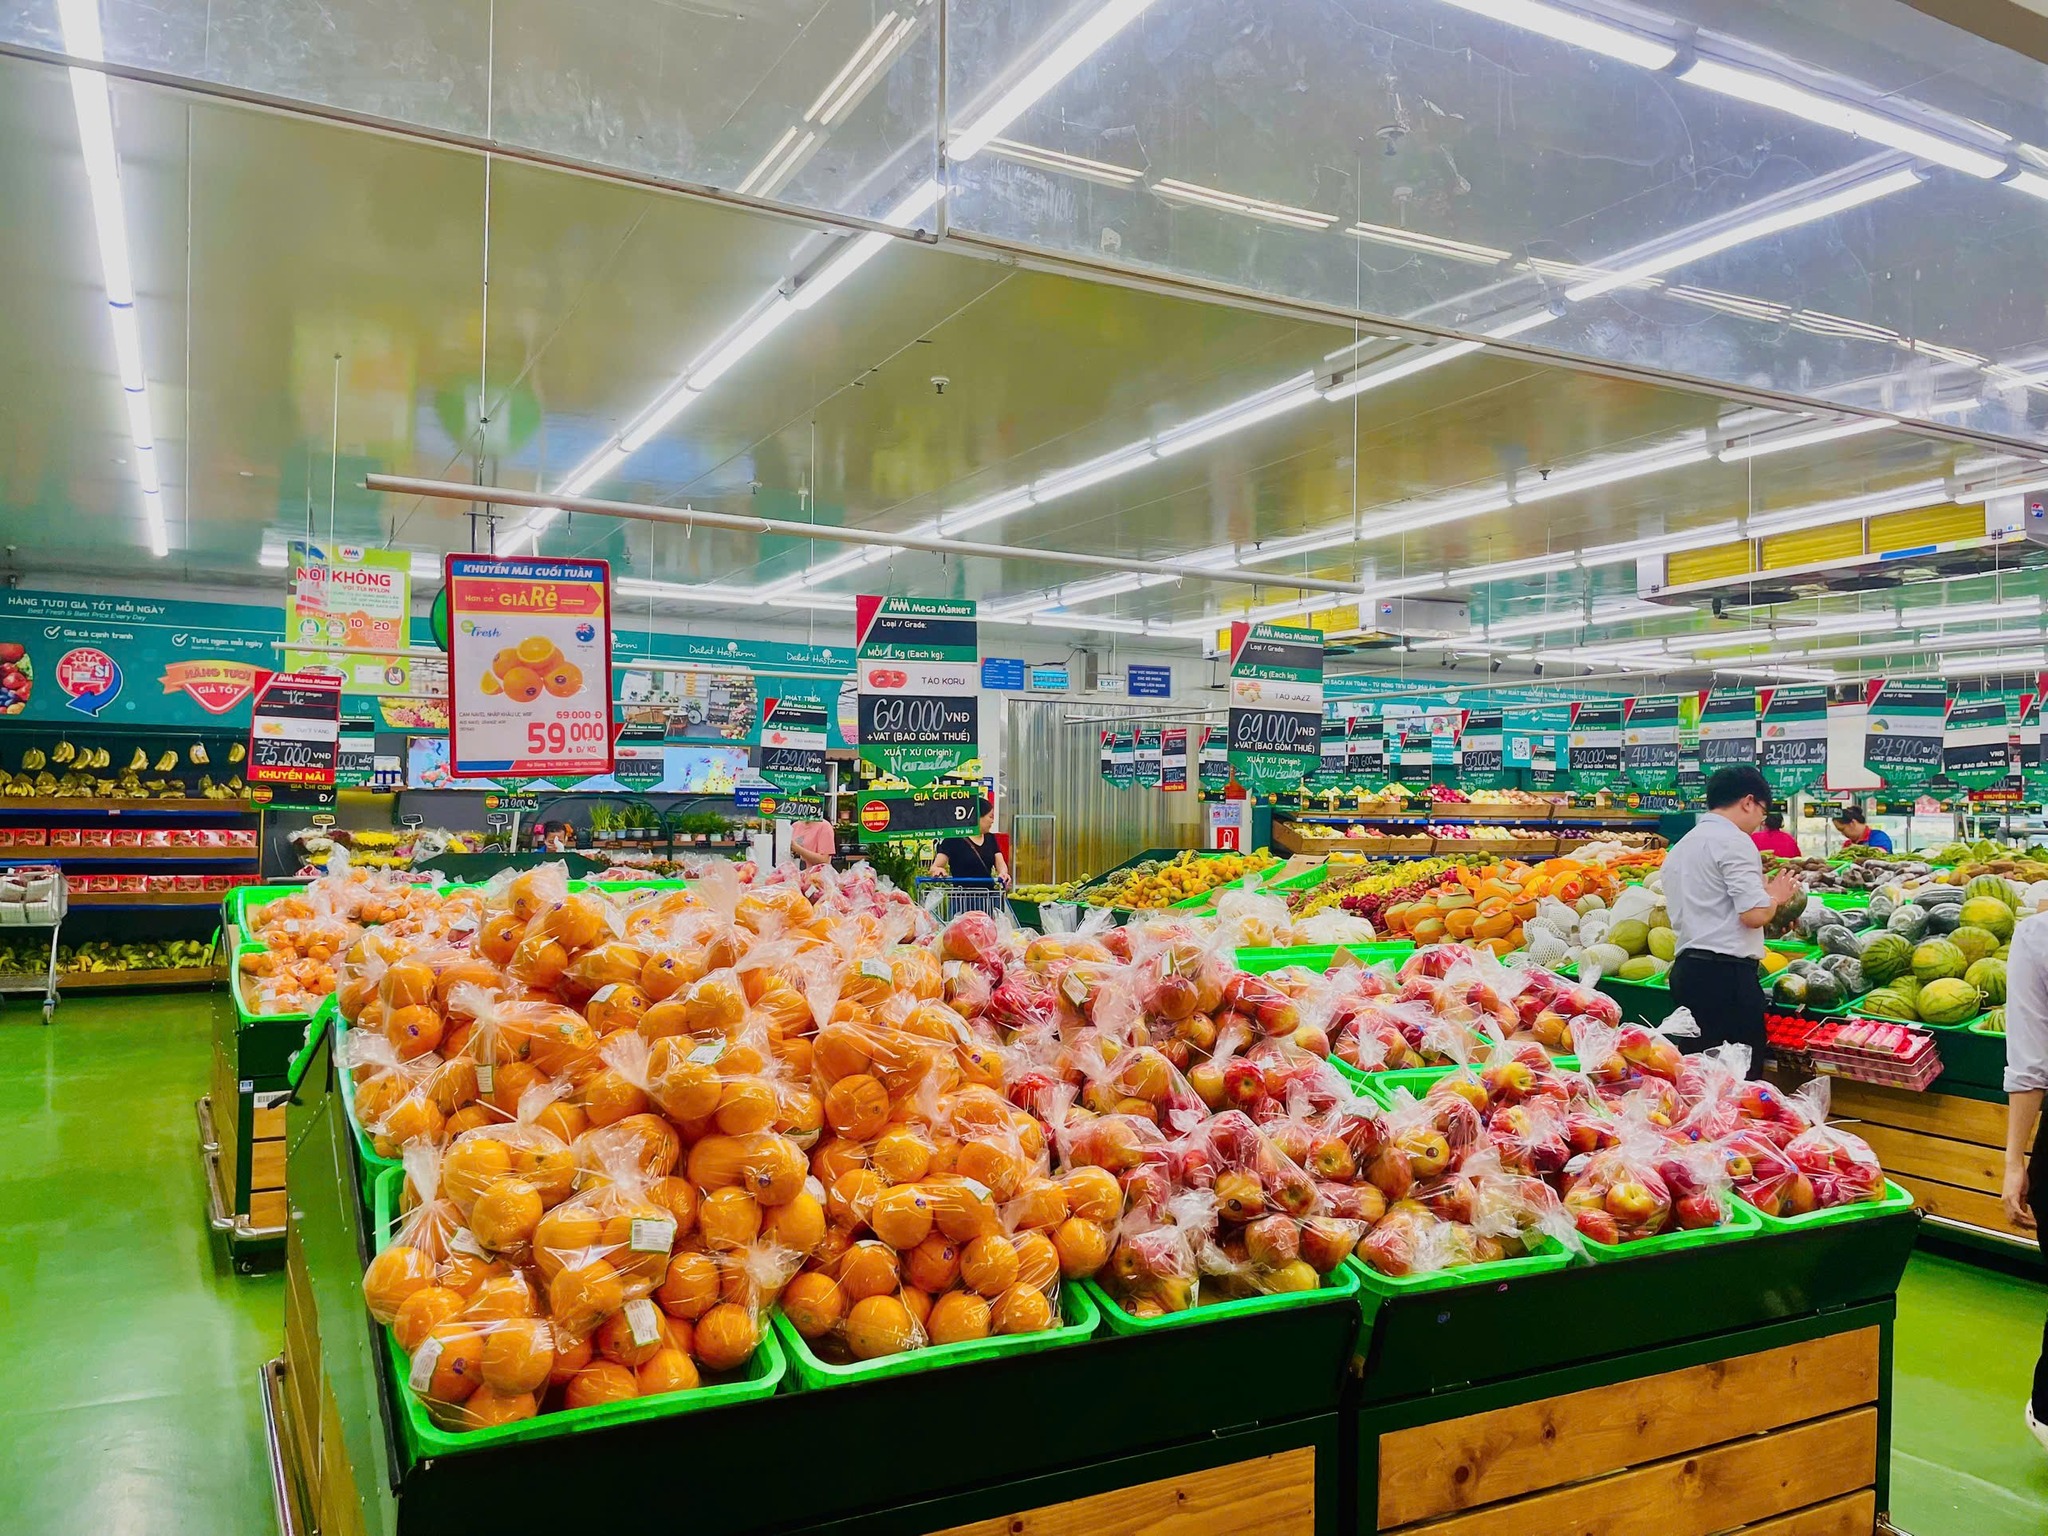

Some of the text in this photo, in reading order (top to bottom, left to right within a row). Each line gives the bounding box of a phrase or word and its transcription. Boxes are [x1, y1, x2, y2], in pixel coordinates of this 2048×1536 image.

[463, 562, 509, 575] KHUYẾN
[535, 565, 561, 576] CUỐI
[565, 566, 593, 578] TUẦN
[332, 569, 391, 587] KHÔNG
[8, 597, 38, 606] HÀNG
[71, 600, 88, 609] GIÁ
[92, 600, 113, 611] TỐT
[116, 601, 134, 612] MỖI
[137, 605, 165, 614] NGÀY
[132, 614, 147, 622] Day
[350, 619, 363, 628] 10
[374, 621, 390, 631] 20
[881, 620, 897, 628] Loại
[112, 632, 133, 640] tranh
[689, 644, 715, 654] Dalat
[786, 651, 810, 661] Dalat
[895, 650, 905, 659] Kg
[907, 650, 929, 659] (Each
[930, 650, 945, 660] kg):
[1269, 671, 1286, 679] (Each
[942, 677, 965, 685] KORU
[197, 684, 240, 694] GIÁ TỐT
[873, 698, 970, 731] 69.000 VNĐ
[867, 729, 970, 742] +VAT (BAO GỒM THUẾ)
[1296, 727, 1315, 736] VNĐ
[1255, 741, 1272, 750] (BAO
[884, 745, 907, 756] XUẤT
[924, 748, 953, 758] (Origin):
[259, 769, 325, 781] KHUYẾN MÃI
[914, 790, 970, 801] GIÁ CHỈ CÒN
